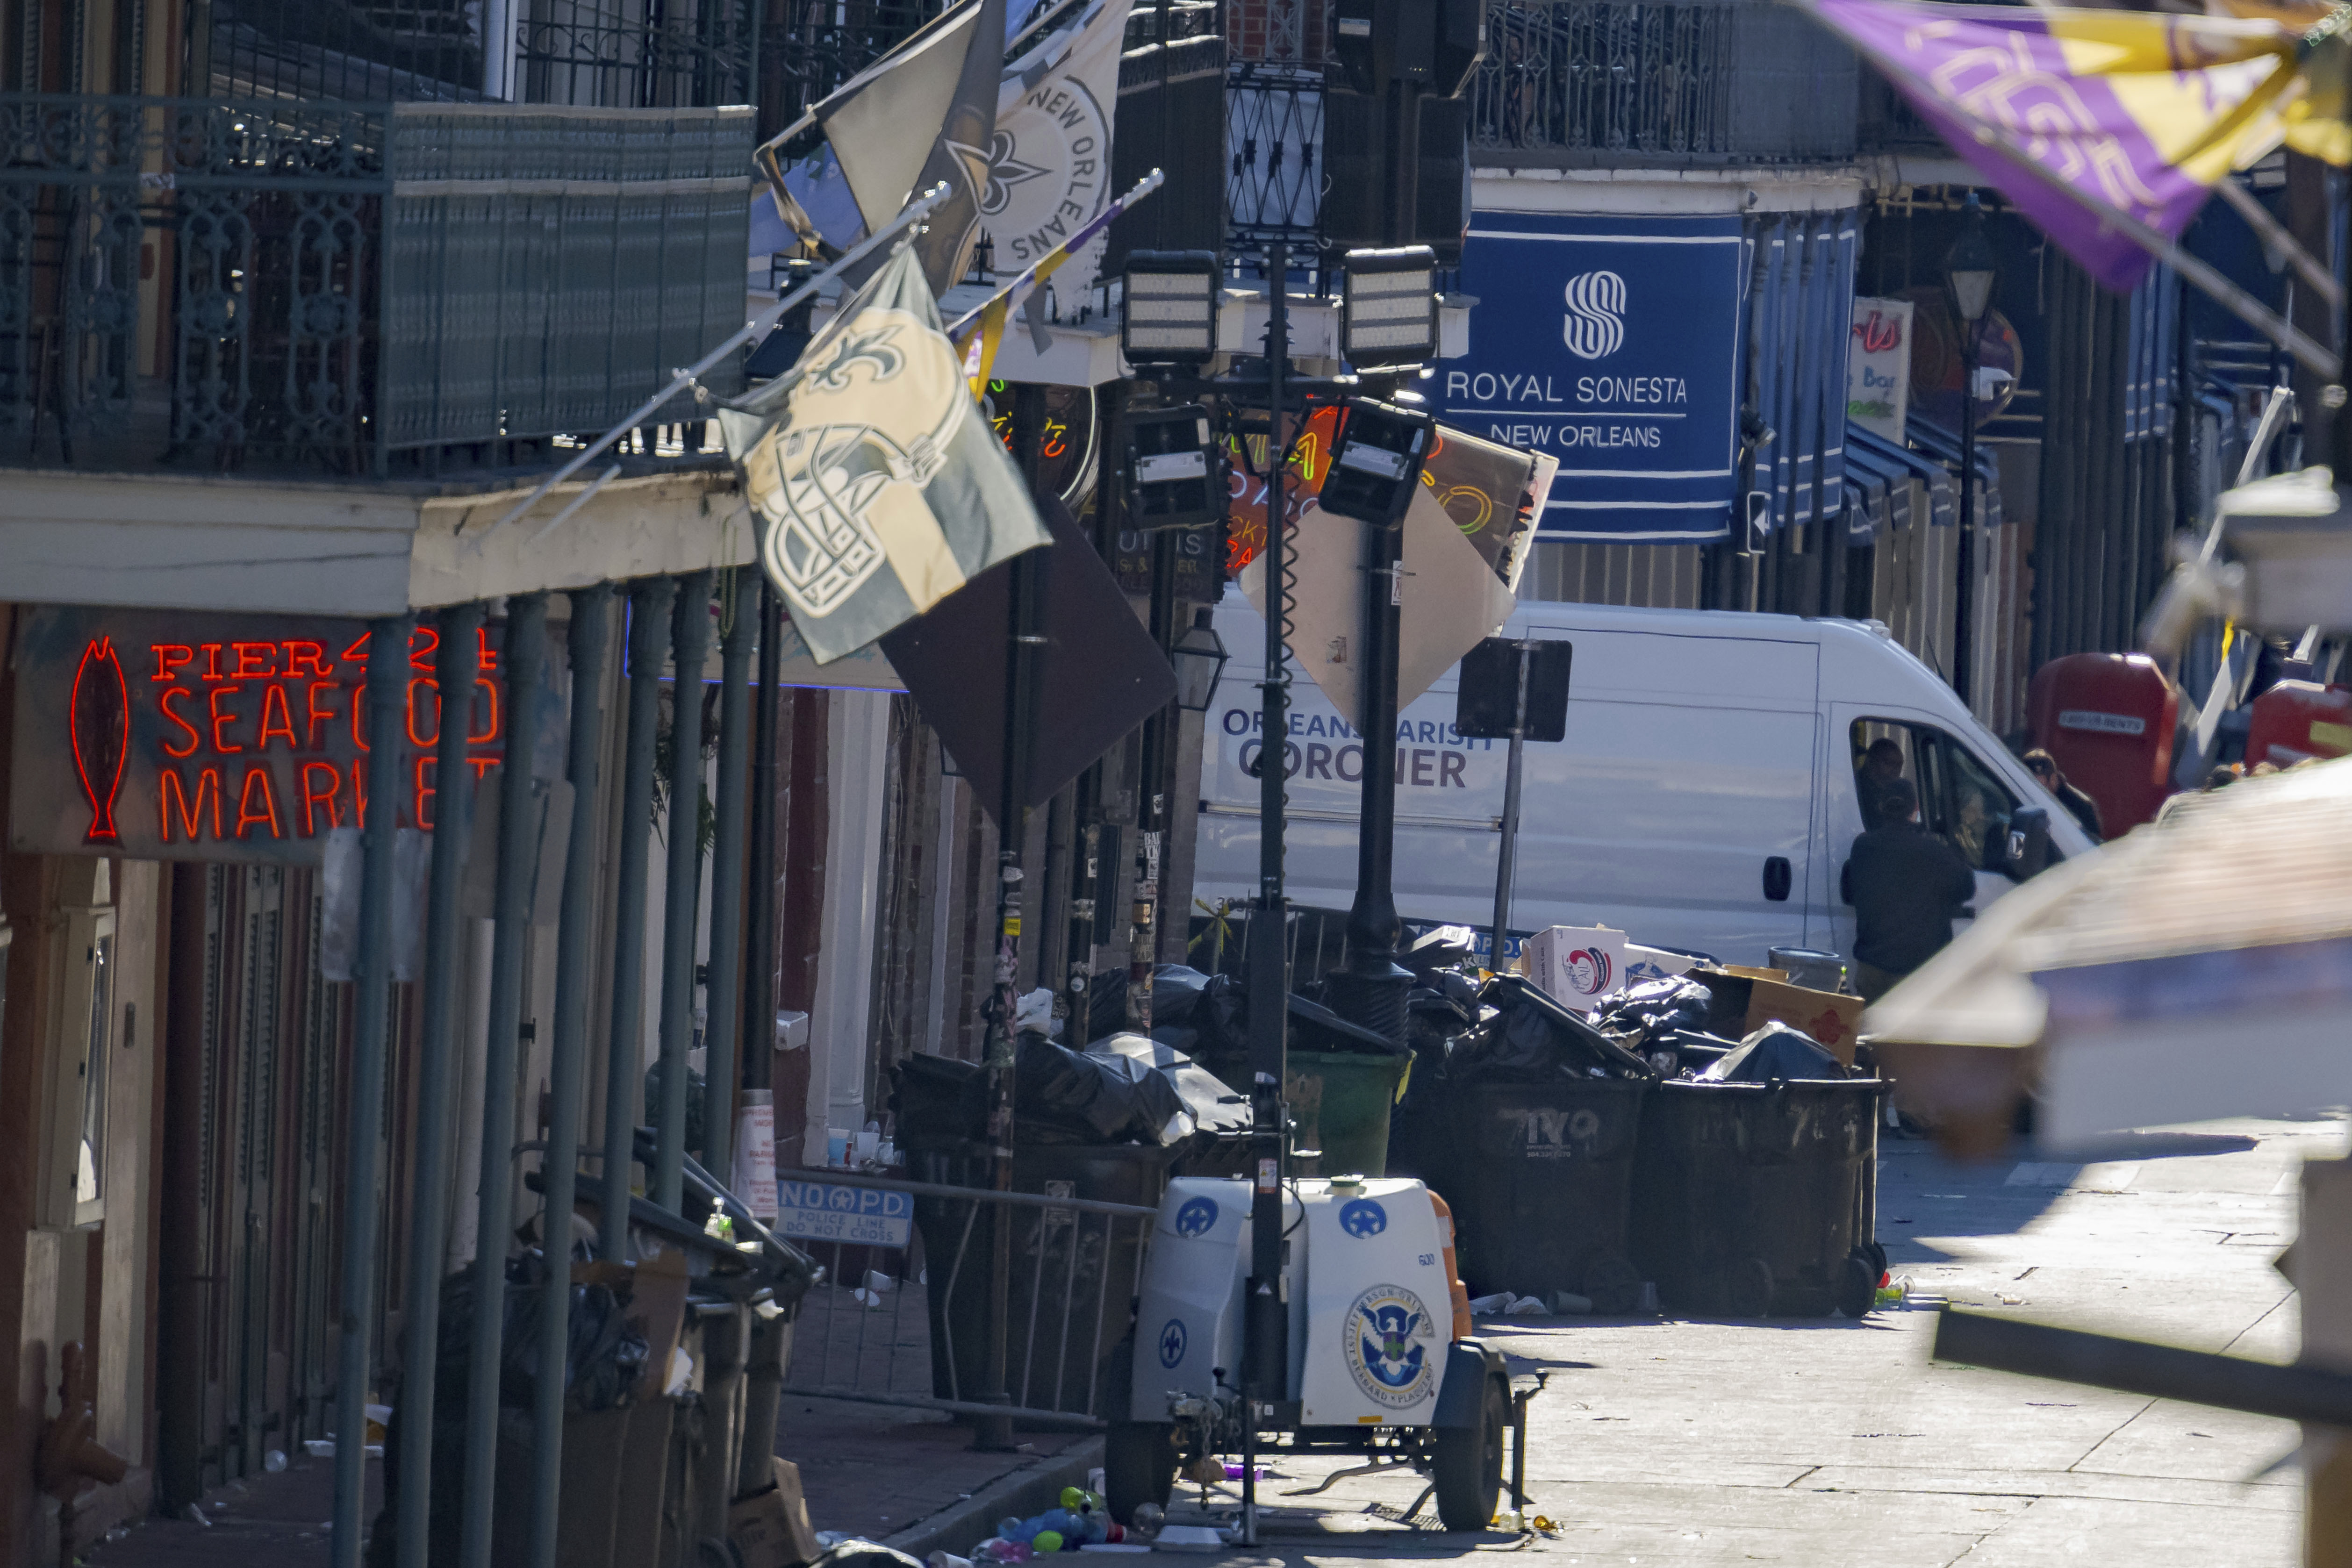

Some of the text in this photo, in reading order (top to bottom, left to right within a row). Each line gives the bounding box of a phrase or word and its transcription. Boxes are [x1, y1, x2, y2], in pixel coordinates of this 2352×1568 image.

[1011, 87, 1096, 260] NEW ORLEANS
[1447, 372, 1687, 403] ROYAL SONESTA
[1491, 424, 1661, 447] NEW ORLEANS
[150, 640, 334, 682] PIER
[787, 1222, 894, 1242] DO NOT CROSS
[798, 1211, 885, 1229] POLICE LINE
